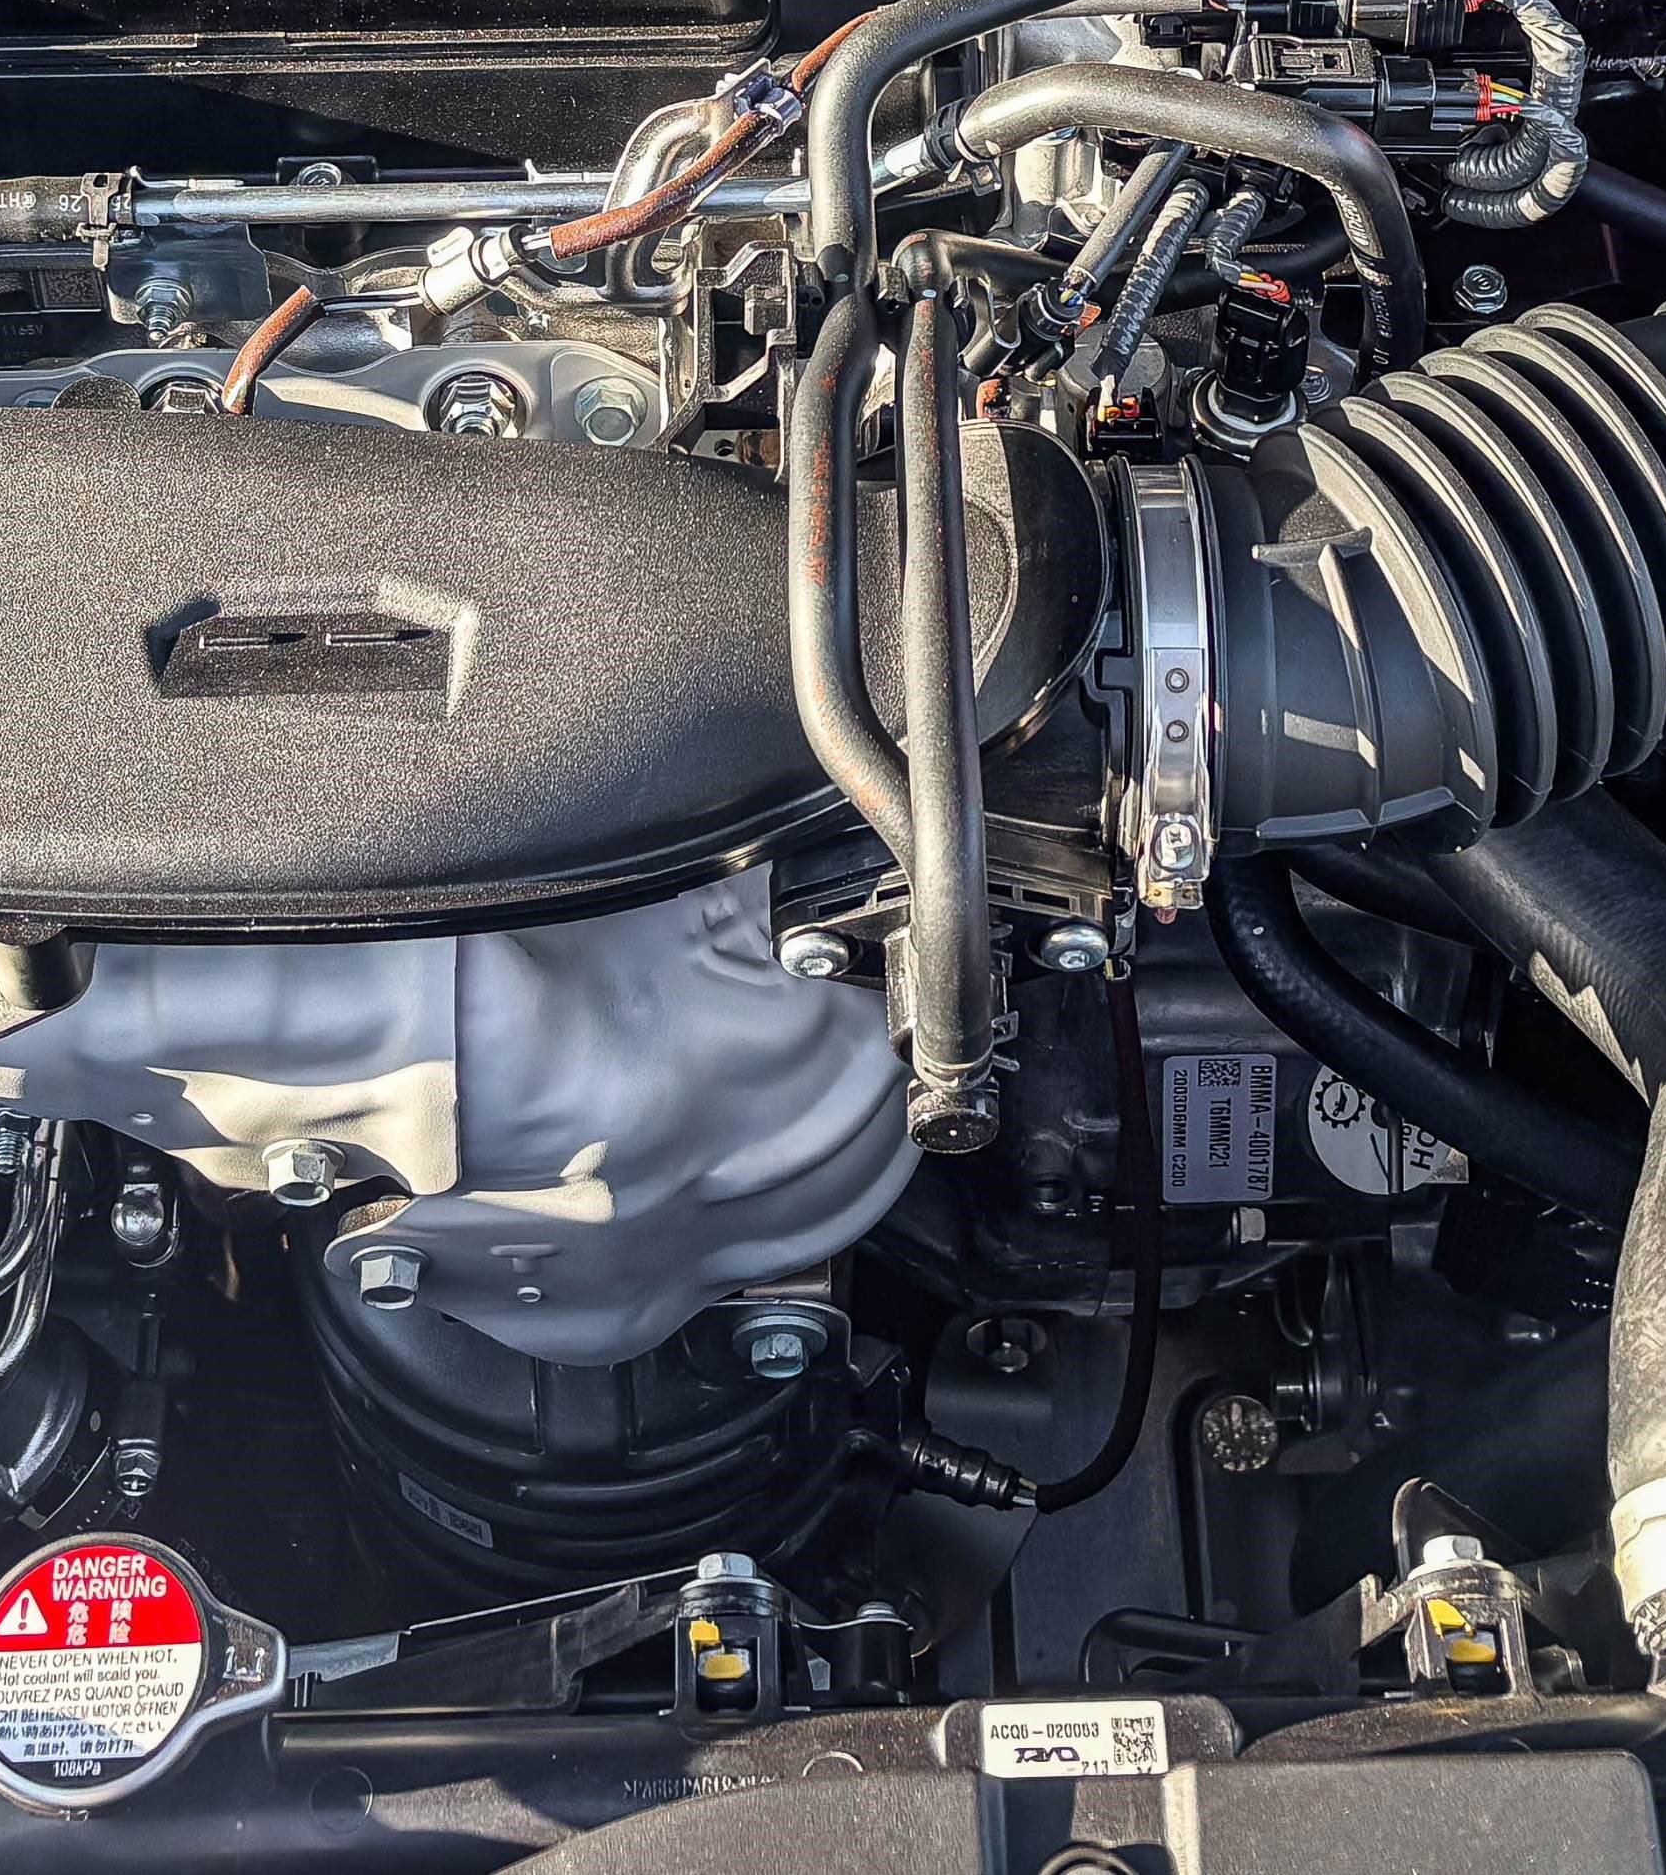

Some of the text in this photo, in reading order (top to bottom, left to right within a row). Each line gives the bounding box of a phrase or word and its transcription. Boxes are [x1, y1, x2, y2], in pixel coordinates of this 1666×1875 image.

[1209, 1097, 1232, 1169] T6MMC21
[1247, 1065, 1273, 1193] BMMA-4001787
[53, 1554, 148, 1580] DANGER
[52, 1575, 167, 1602] WARNUNG
[0, 1648, 178, 1670] NEVER OPEN WHEN HOT.
[23, 1670, 70, 1685] coolant
[74, 1669, 93, 1683] will
[54, 1687, 81, 1702] PAS
[85, 1685, 133, 1701] QUAND
[137, 1682, 184, 1699] CHAUD
[92, 1703, 132, 1718] MOTOR
[53, 1759, 102, 1778] 108kPa
